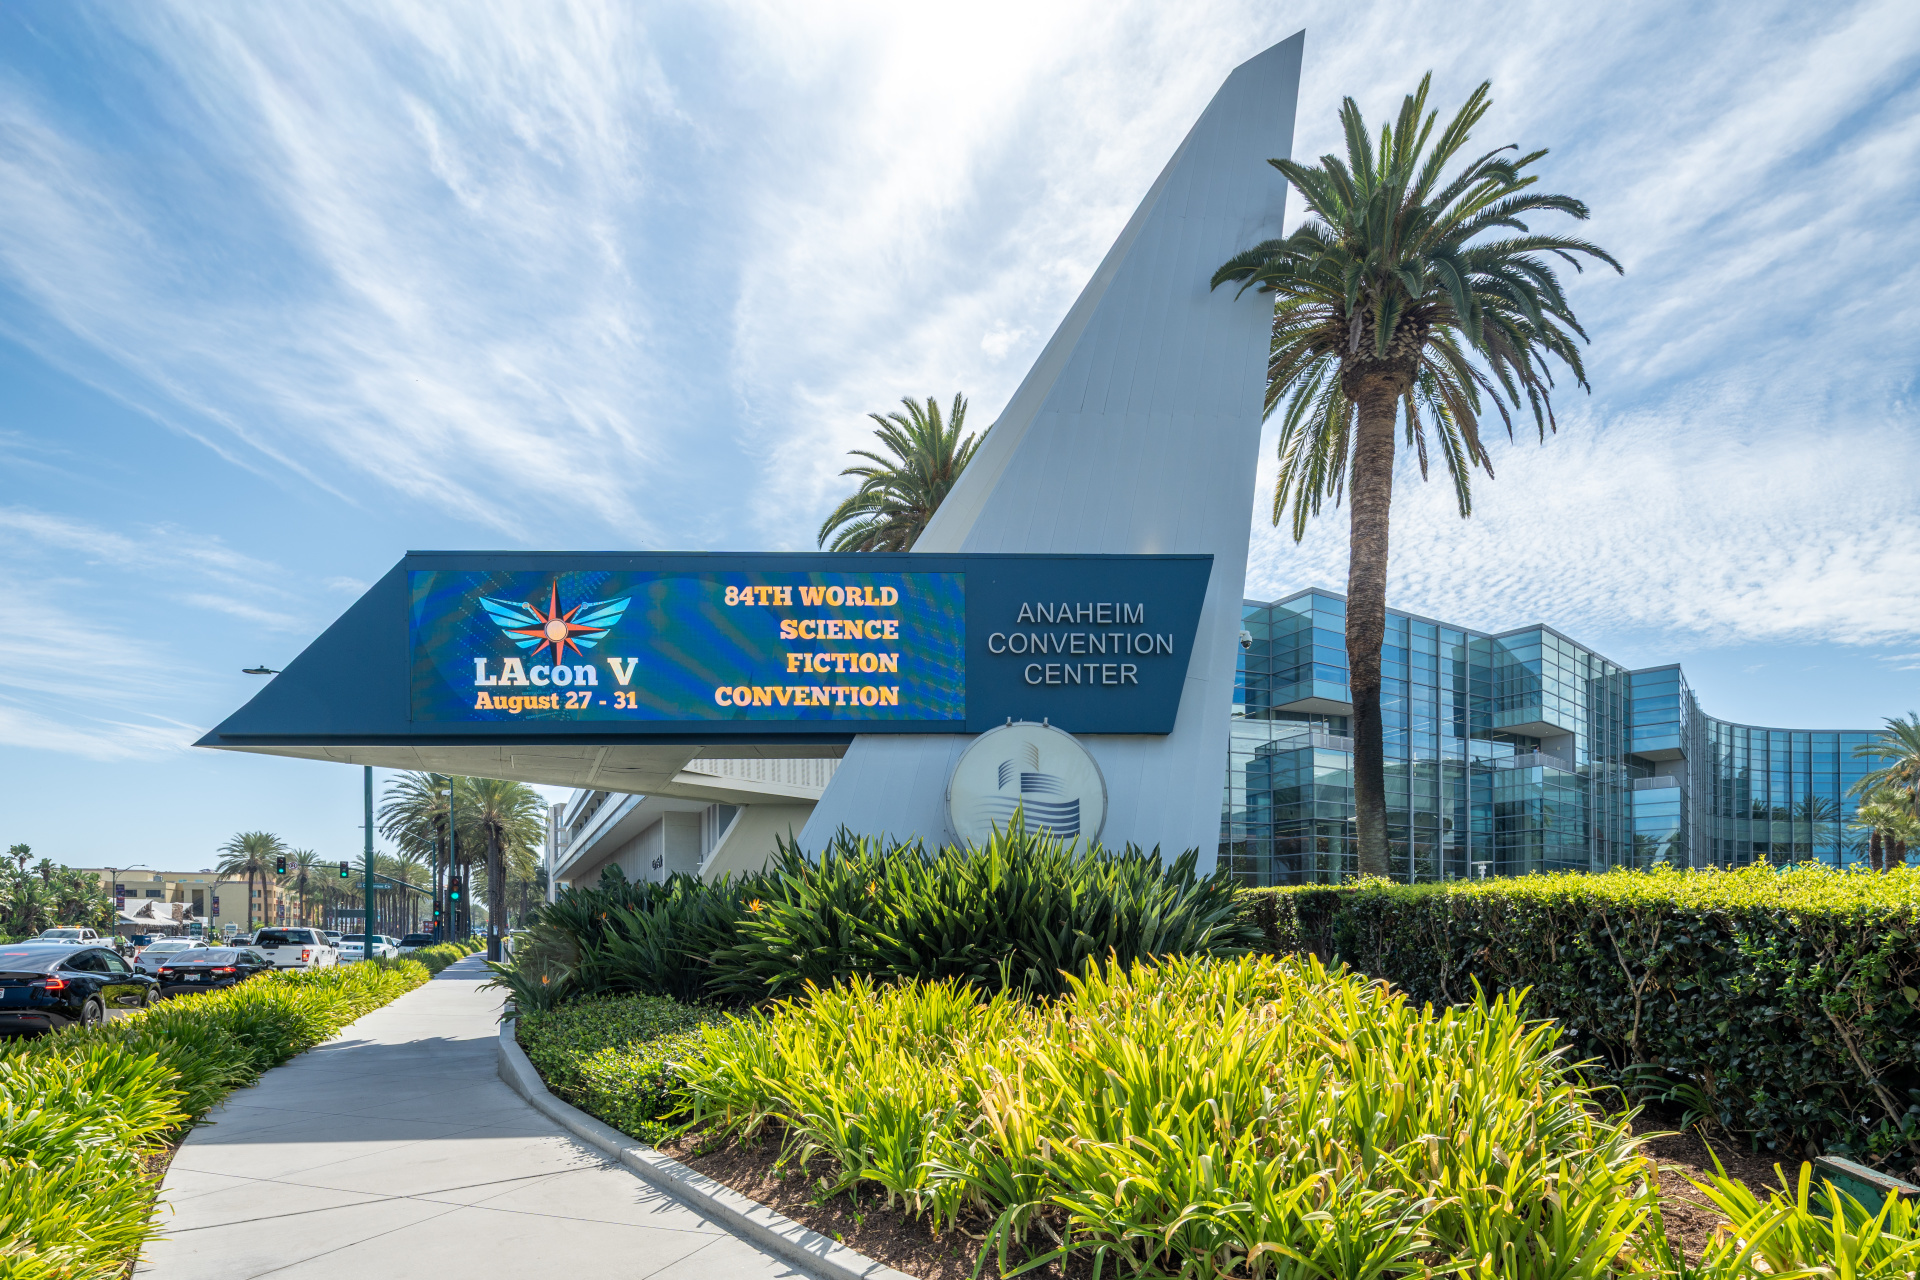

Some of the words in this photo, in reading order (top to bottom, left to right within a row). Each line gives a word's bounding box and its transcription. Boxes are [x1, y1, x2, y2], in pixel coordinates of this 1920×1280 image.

[724, 585, 793, 607] 84TH
[798, 586, 899, 607] WORLD
[1016, 602, 1144, 624] ANAHEIM
[780, 619, 899, 640] SCIENCE
[988, 632, 1173, 654] CONVENTION
[474, 657, 599, 686] LAcon
[607, 657, 639, 686] V
[786, 652, 899, 673] FICTION
[1024, 663, 1138, 684] CENTER
[474, 691, 560, 714] August
[564, 691, 593, 710] 27
[613, 691, 638, 710] 31
[714, 686, 899, 707] CONVENTION
